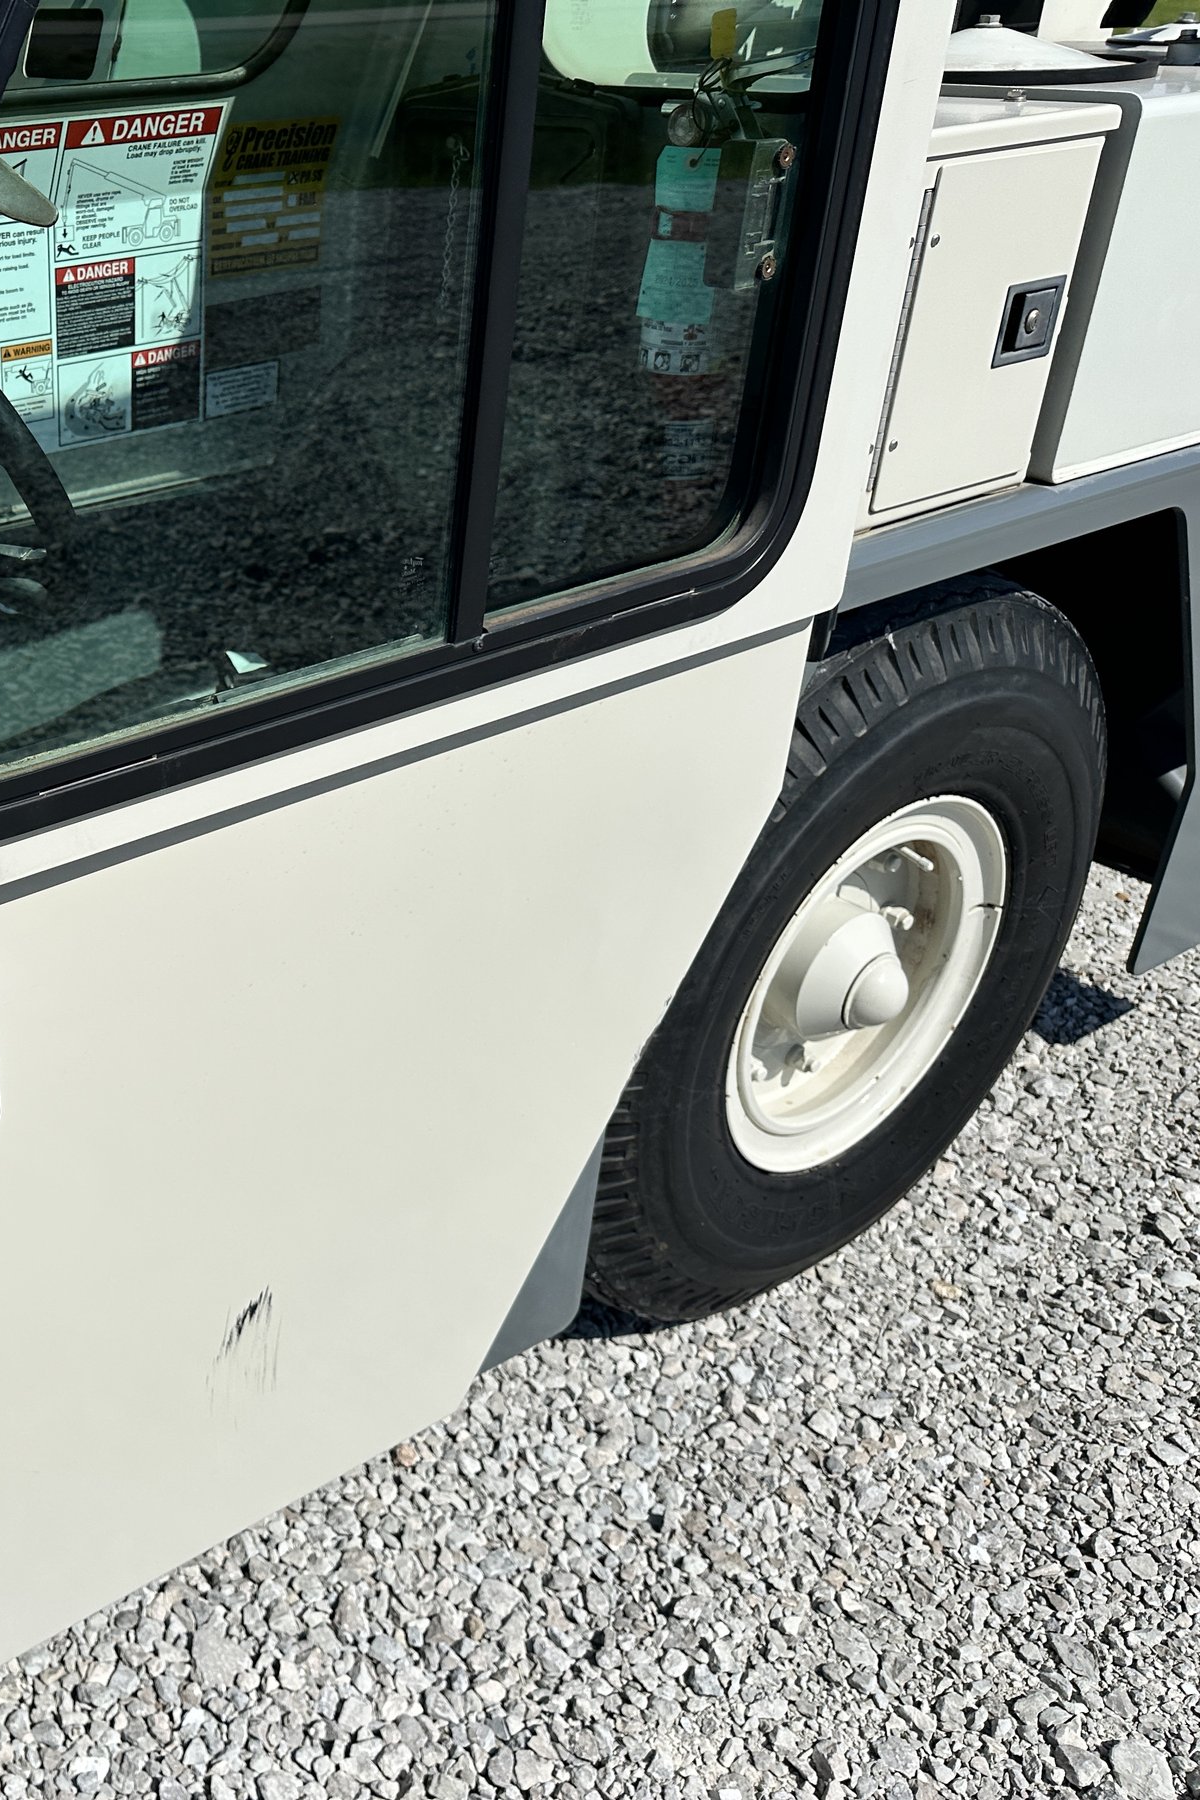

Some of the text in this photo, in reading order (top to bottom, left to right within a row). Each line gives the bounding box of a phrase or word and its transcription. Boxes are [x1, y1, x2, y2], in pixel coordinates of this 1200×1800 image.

[111, 111, 205, 140] DANGER
[242, 123, 337, 152] Precision
[126, 151, 142, 159] Load
[158, 148, 173, 156] drop
[175, 145, 201, 154] abruptly.
[128, 143, 151, 151] CRANE
[152, 140, 181, 149] FAILURE
[237, 147, 330, 170] CRANE TRAINING
[169, 203, 198, 212] OVERLOAD
[26, 227, 44, 235] result
[98, 231, 119, 239] PEOPLE
[17, 235, 36, 246] injury.
[82, 241, 101, 249] CLEAR
[77, 261, 129, 280] DANGER
[13, 343, 49, 356] WARNING
[147, 344, 195, 363] DANGER
